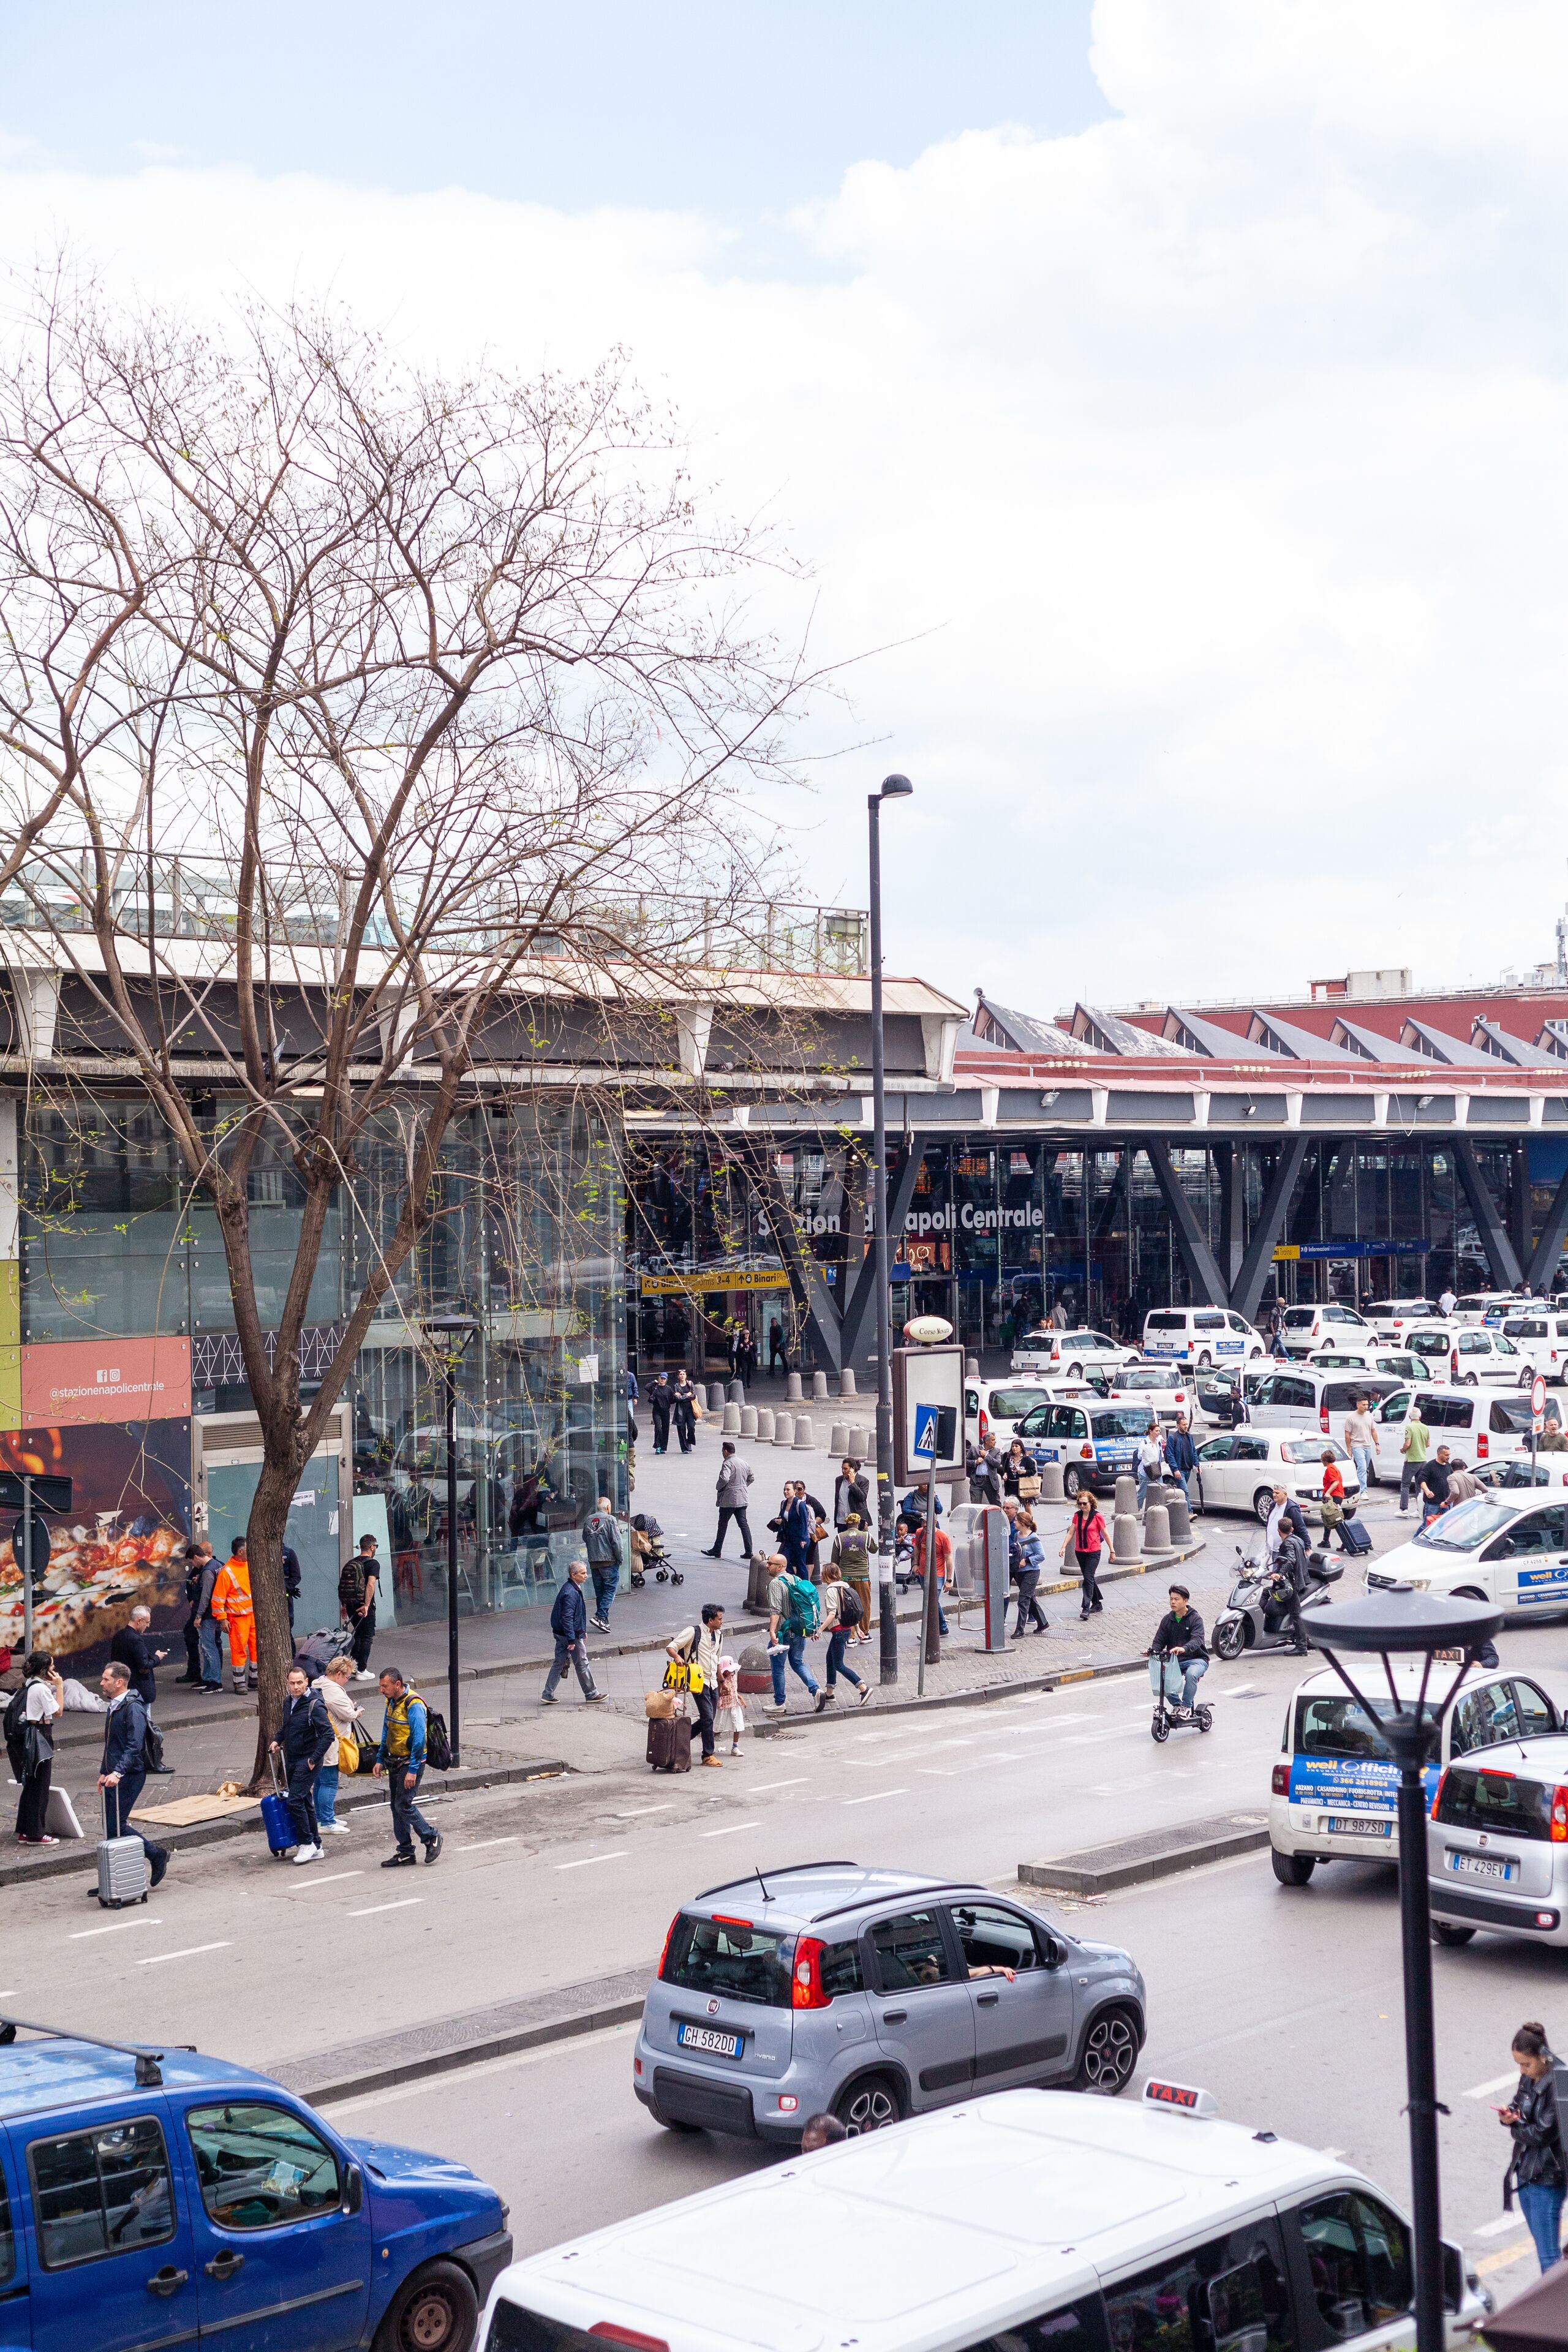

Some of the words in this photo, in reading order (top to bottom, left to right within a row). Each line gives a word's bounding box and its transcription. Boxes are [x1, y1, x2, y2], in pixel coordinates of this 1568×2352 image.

[864, 1205, 876, 1232] d
[905, 1202, 956, 1237] apoli
[961, 1201, 1042, 1229] Centrale
[717, 1275, 730, 1284] 2-4
[754, 1273, 776, 1283] Binari
[777, 1272, 788, 1281] Pla
[50, 1381, 164, 1400] @stazionenapolicentrale
[1529, 1571, 1552, 1580] well
[1434, 1649, 1459, 1659] TAXI
[1306, 1760, 1337, 1770] well
[1355, 1779, 1388, 1787] 2418964
[1317, 1785, 1347, 1794] CASANDRINO
[1349, 1787, 1383, 1796] FUORIGROTTA
[1327, 1798, 1351, 1807] MECCANICA
[1353, 1800, 1368, 1809] CENTRO
[1369, 1801, 1389, 1811] REVISIONI
[1336, 1819, 1349, 1830] DT
[1352, 1820, 1384, 1833] 987SD
[1460, 1857, 1471, 1870] ET
[1475, 1861, 1504, 1877] 429EV
[685, 2027, 699, 2045] GH
[701, 2032, 735, 2052] 582DD
[754, 2052, 776, 2061] HYBRID
[1150, 2082, 1195, 2107] TAXI
